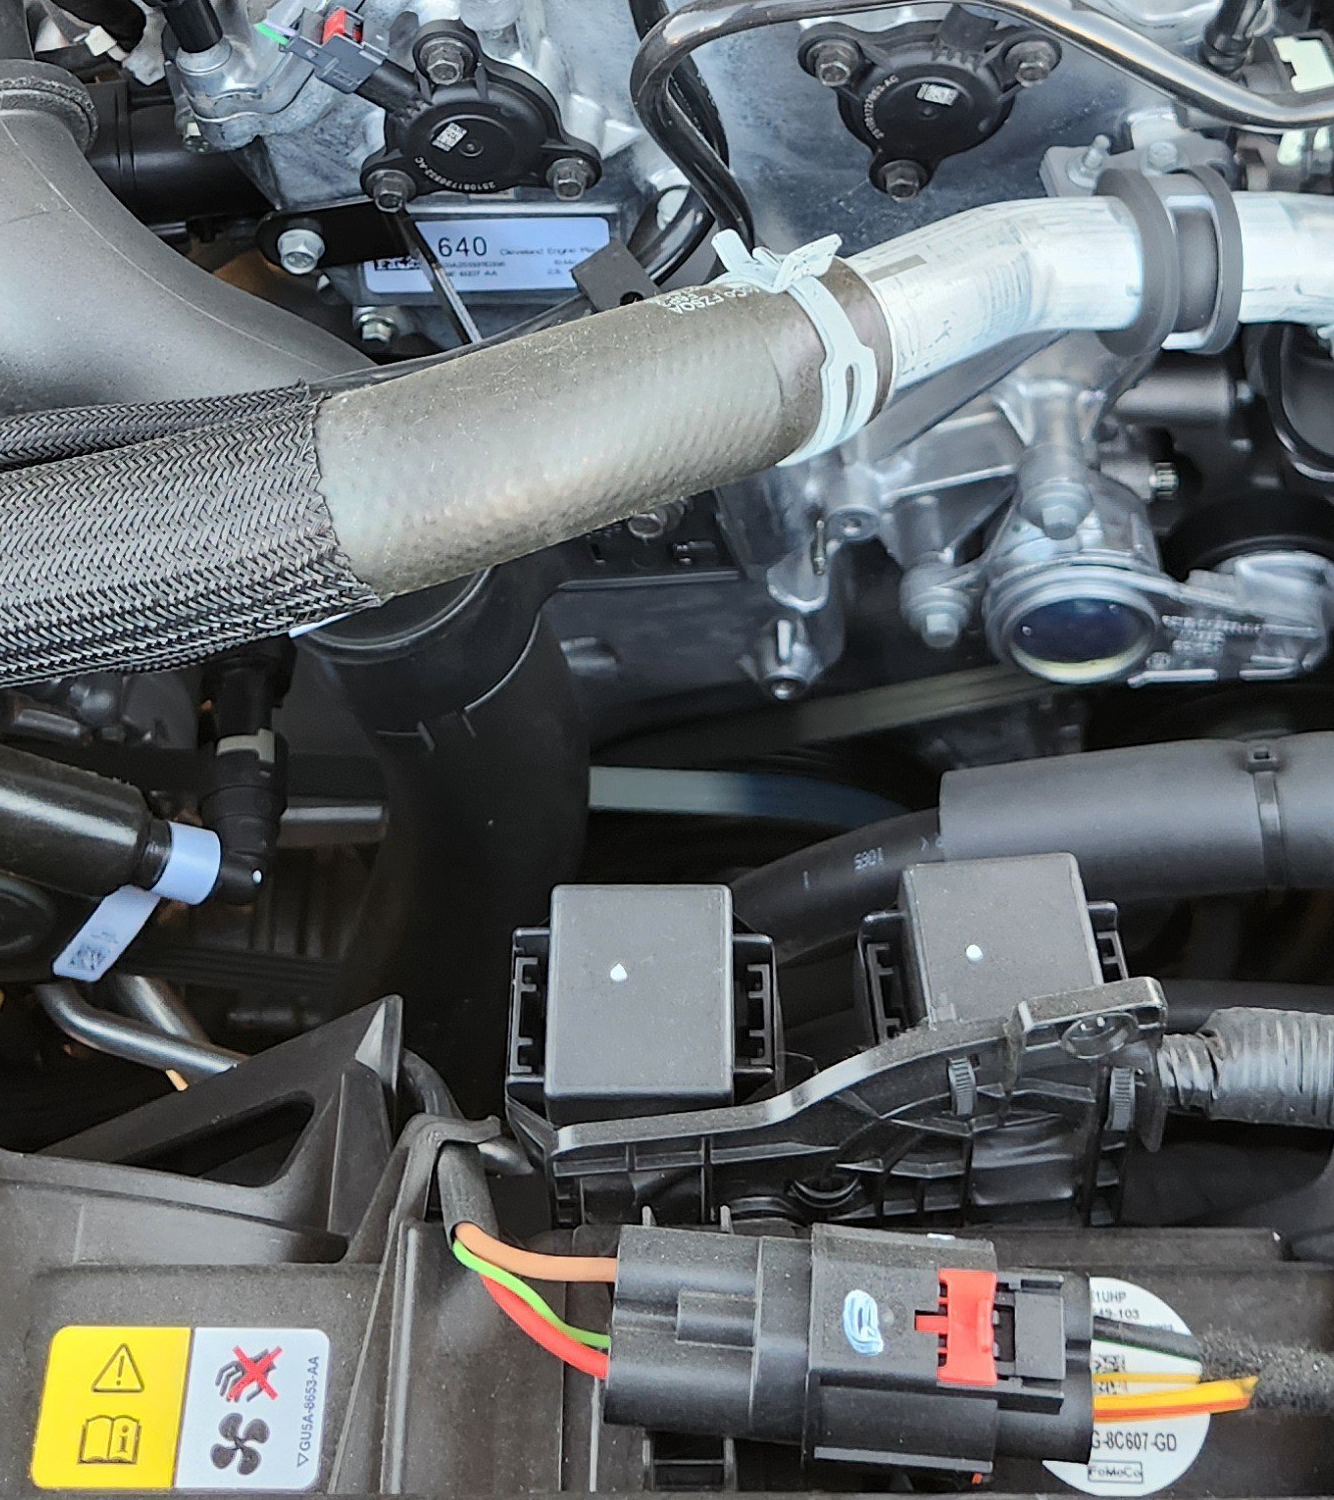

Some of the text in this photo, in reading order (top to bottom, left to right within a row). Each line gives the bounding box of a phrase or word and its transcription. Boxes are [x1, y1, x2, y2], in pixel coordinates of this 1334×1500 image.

[438, 236, 487, 257] 640
[1092, 1290, 1127, 1304] 1UHP
[299, 1355, 319, 1452] GU5A-8653-AA
[1091, 1430, 1178, 1452] G-8C607-GD
